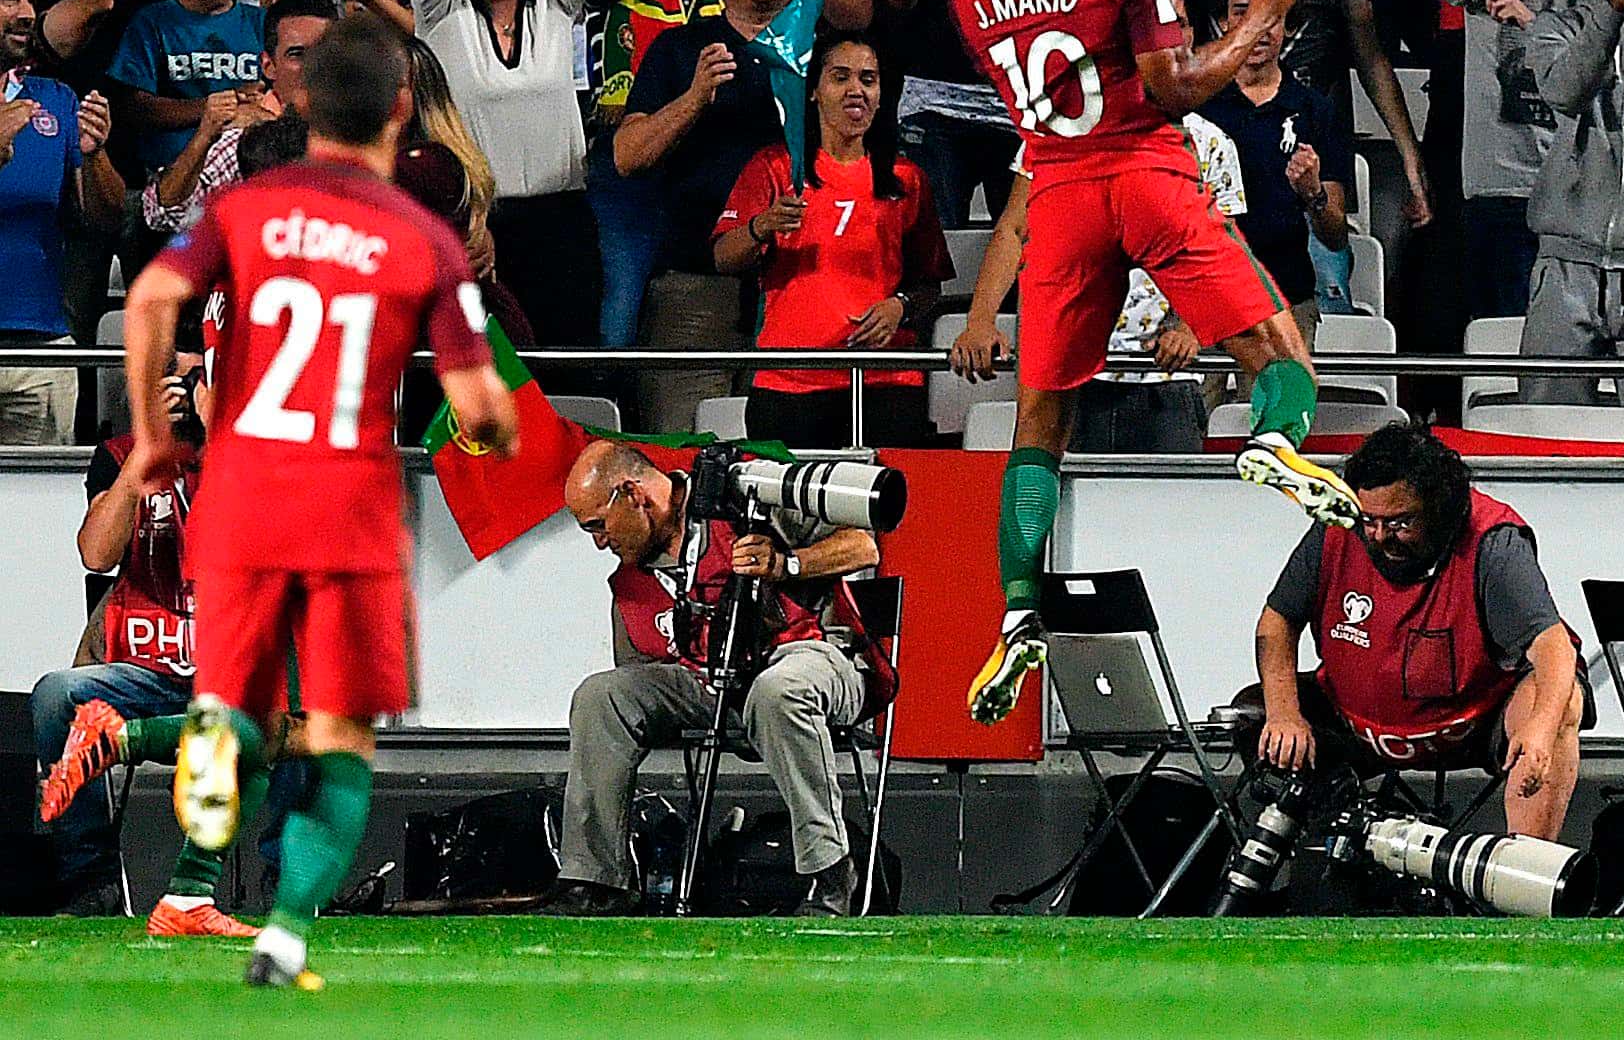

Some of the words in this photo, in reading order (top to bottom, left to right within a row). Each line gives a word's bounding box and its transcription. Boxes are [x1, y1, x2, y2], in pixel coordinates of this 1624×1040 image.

[167, 52, 258, 81] BERG
[988, 30, 1104, 138] 10
[834, 200, 855, 236] 7
[232, 275, 379, 450] 21
